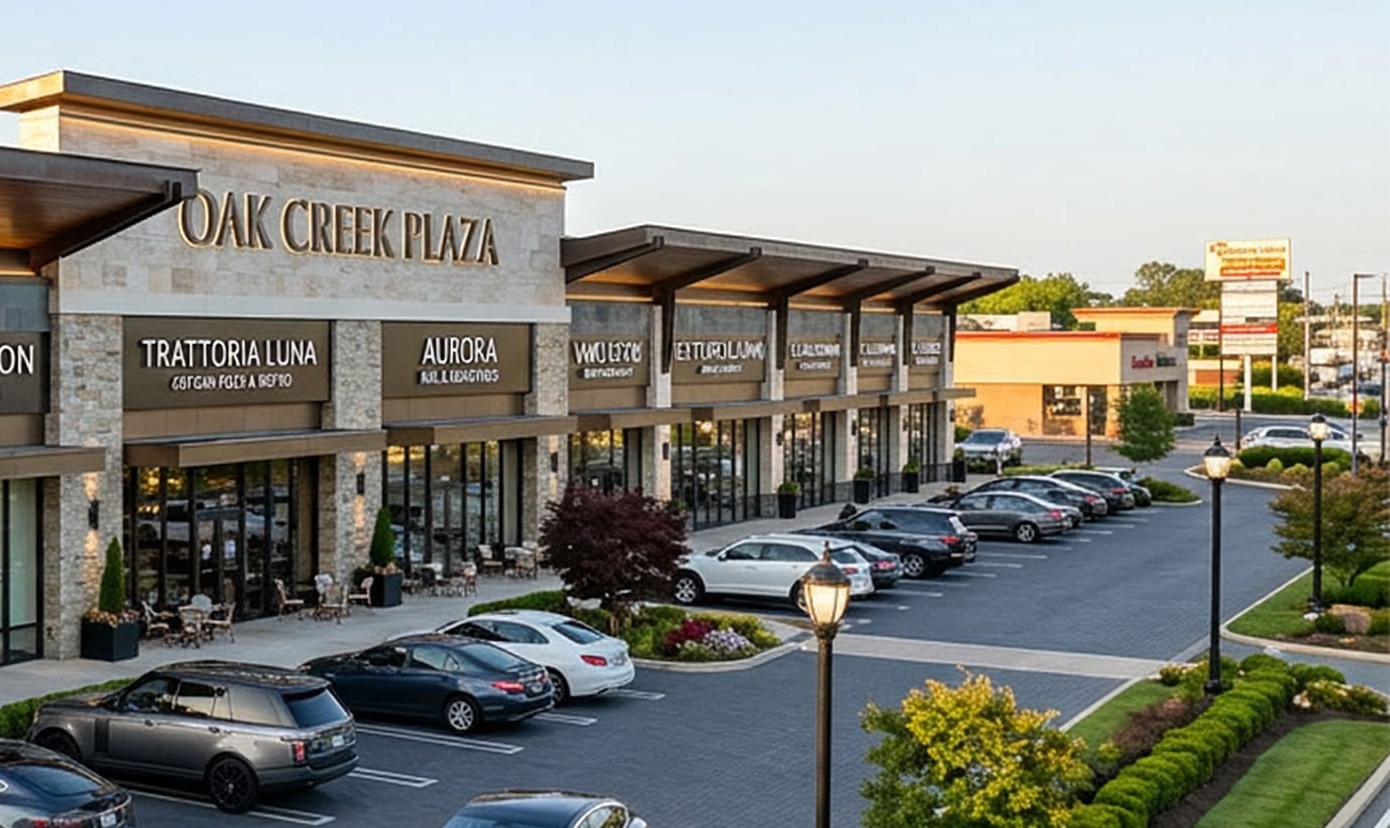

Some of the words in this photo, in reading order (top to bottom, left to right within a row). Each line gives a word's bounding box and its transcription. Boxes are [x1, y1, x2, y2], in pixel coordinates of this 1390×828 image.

[177, 190, 273, 249] OAK
[279, 197, 395, 259] CREEK
[401, 210, 499, 266] PLAZA
[141, 339, 261, 368] TRATTORIA
[265, 340, 318, 366] LUNA
[421, 336, 498, 365] AURORA
